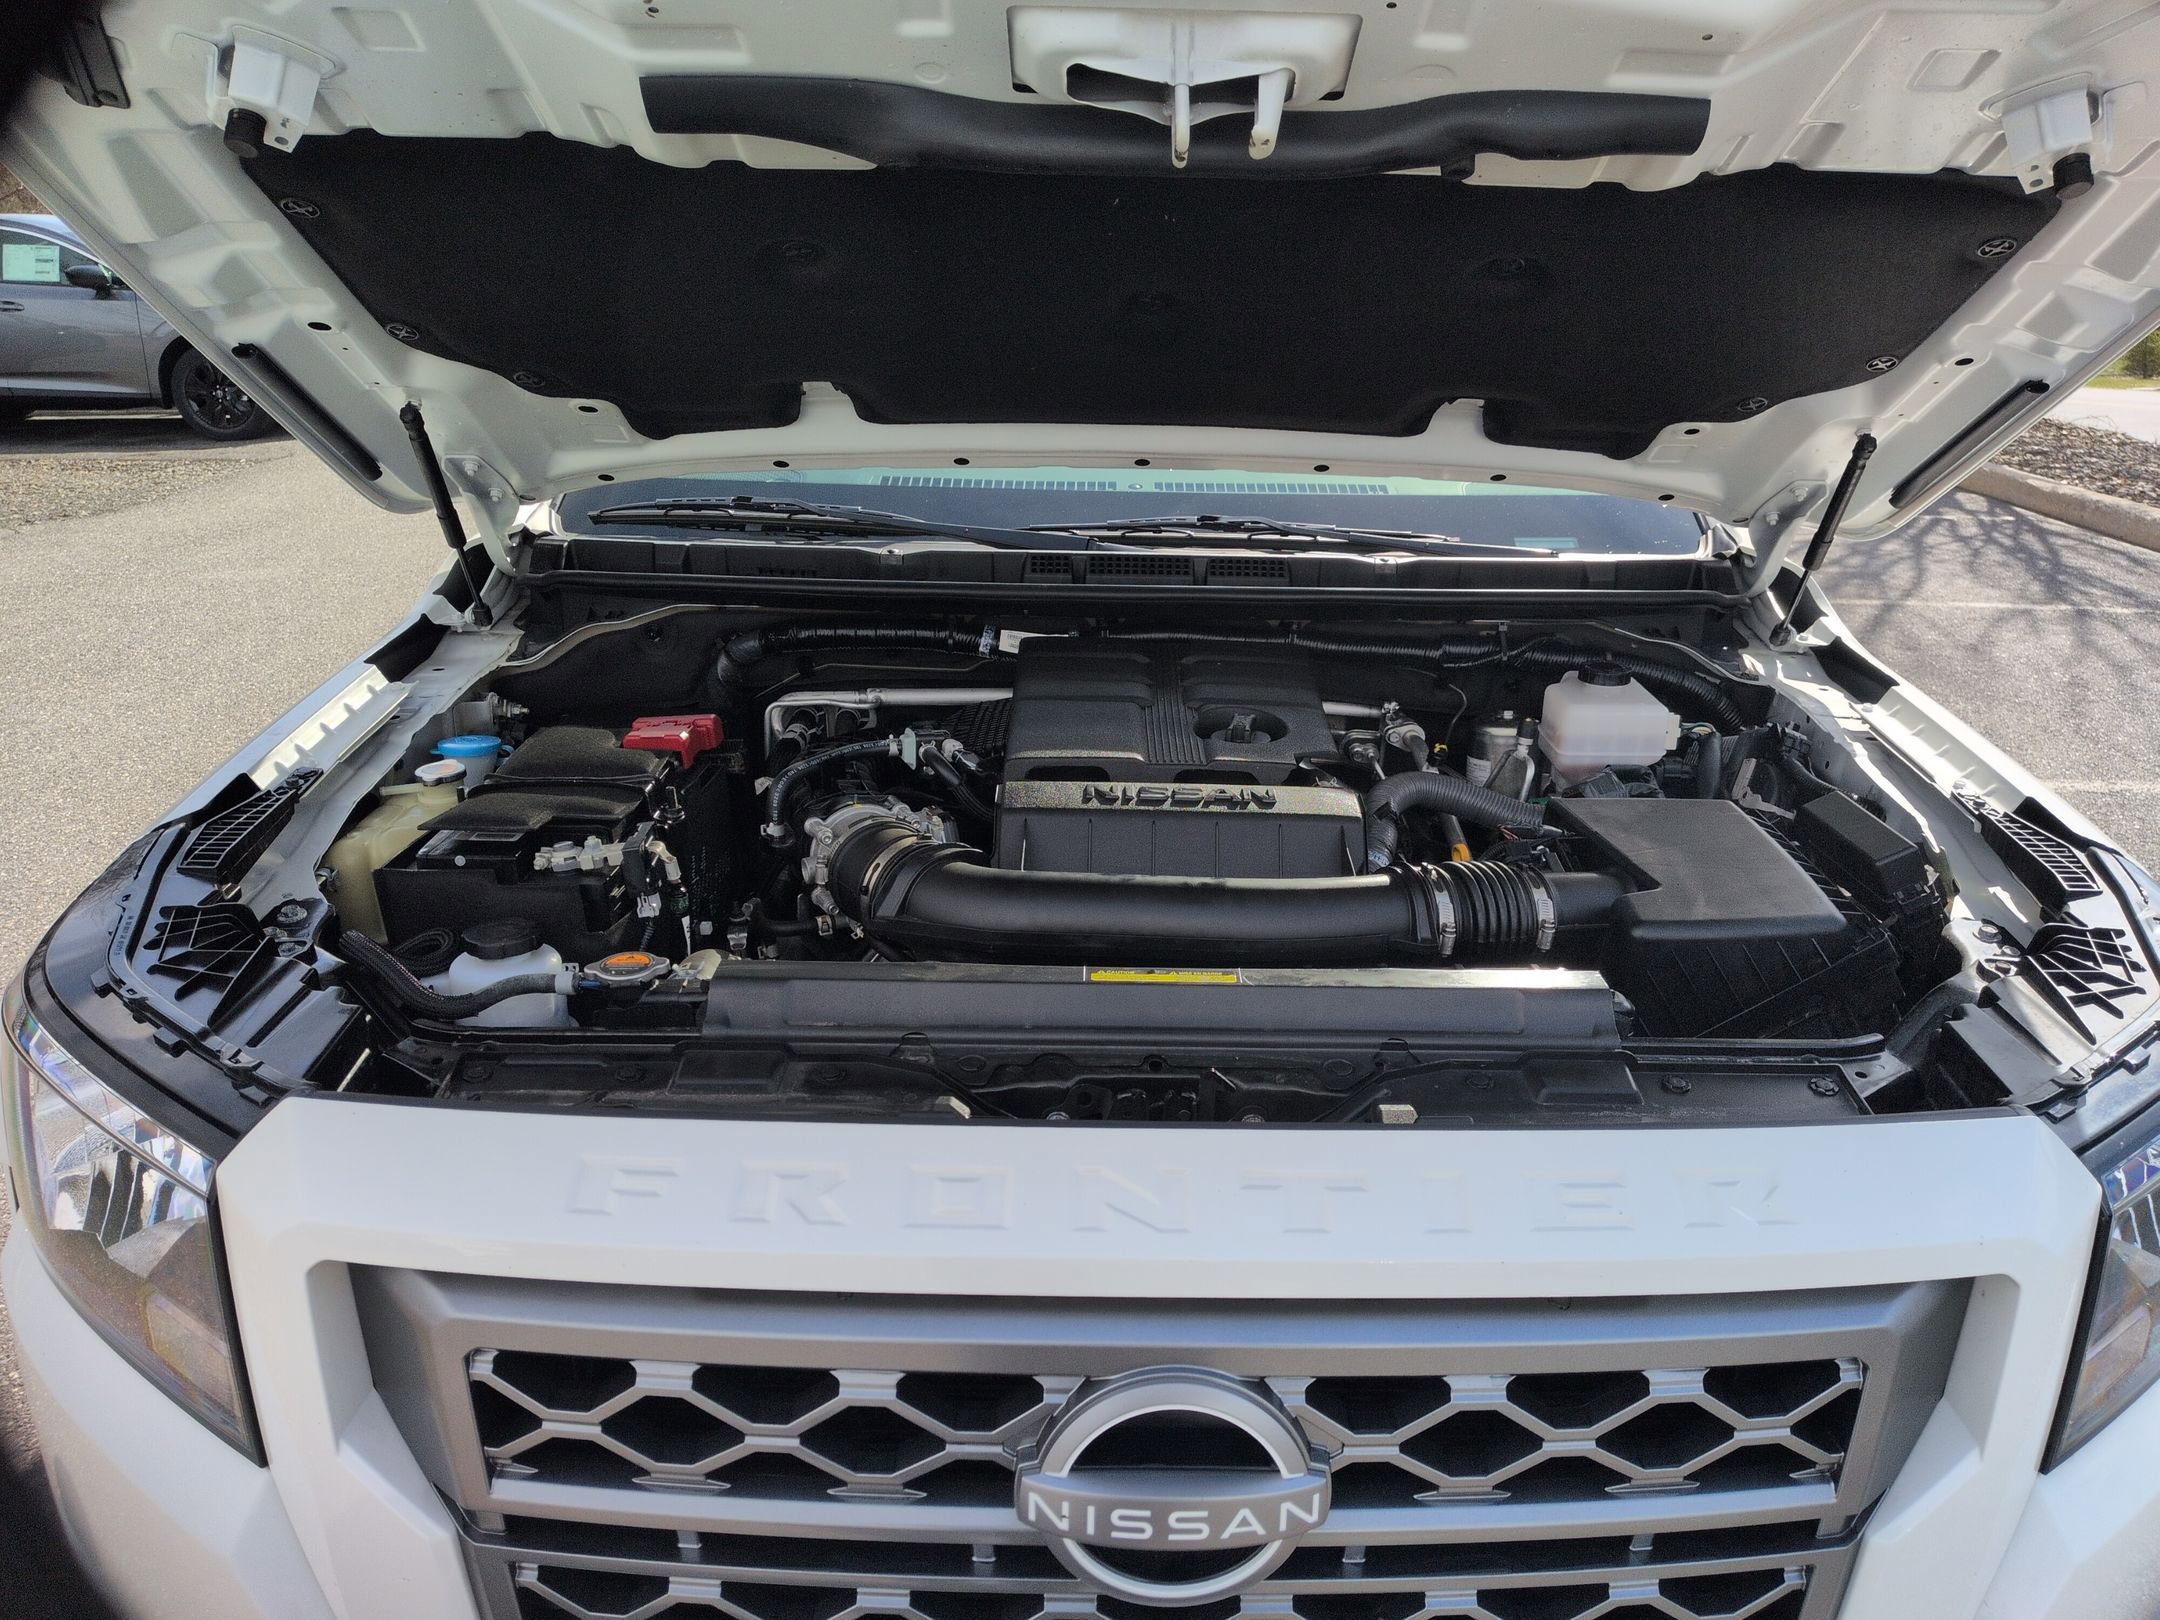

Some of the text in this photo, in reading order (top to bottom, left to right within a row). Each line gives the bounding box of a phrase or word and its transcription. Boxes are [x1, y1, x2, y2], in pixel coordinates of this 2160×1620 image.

[1082, 784, 1278, 810] NISSAN
[564, 1155, 1803, 1235] FRONTIER
[1027, 1491, 1320, 1541] NISSAN
